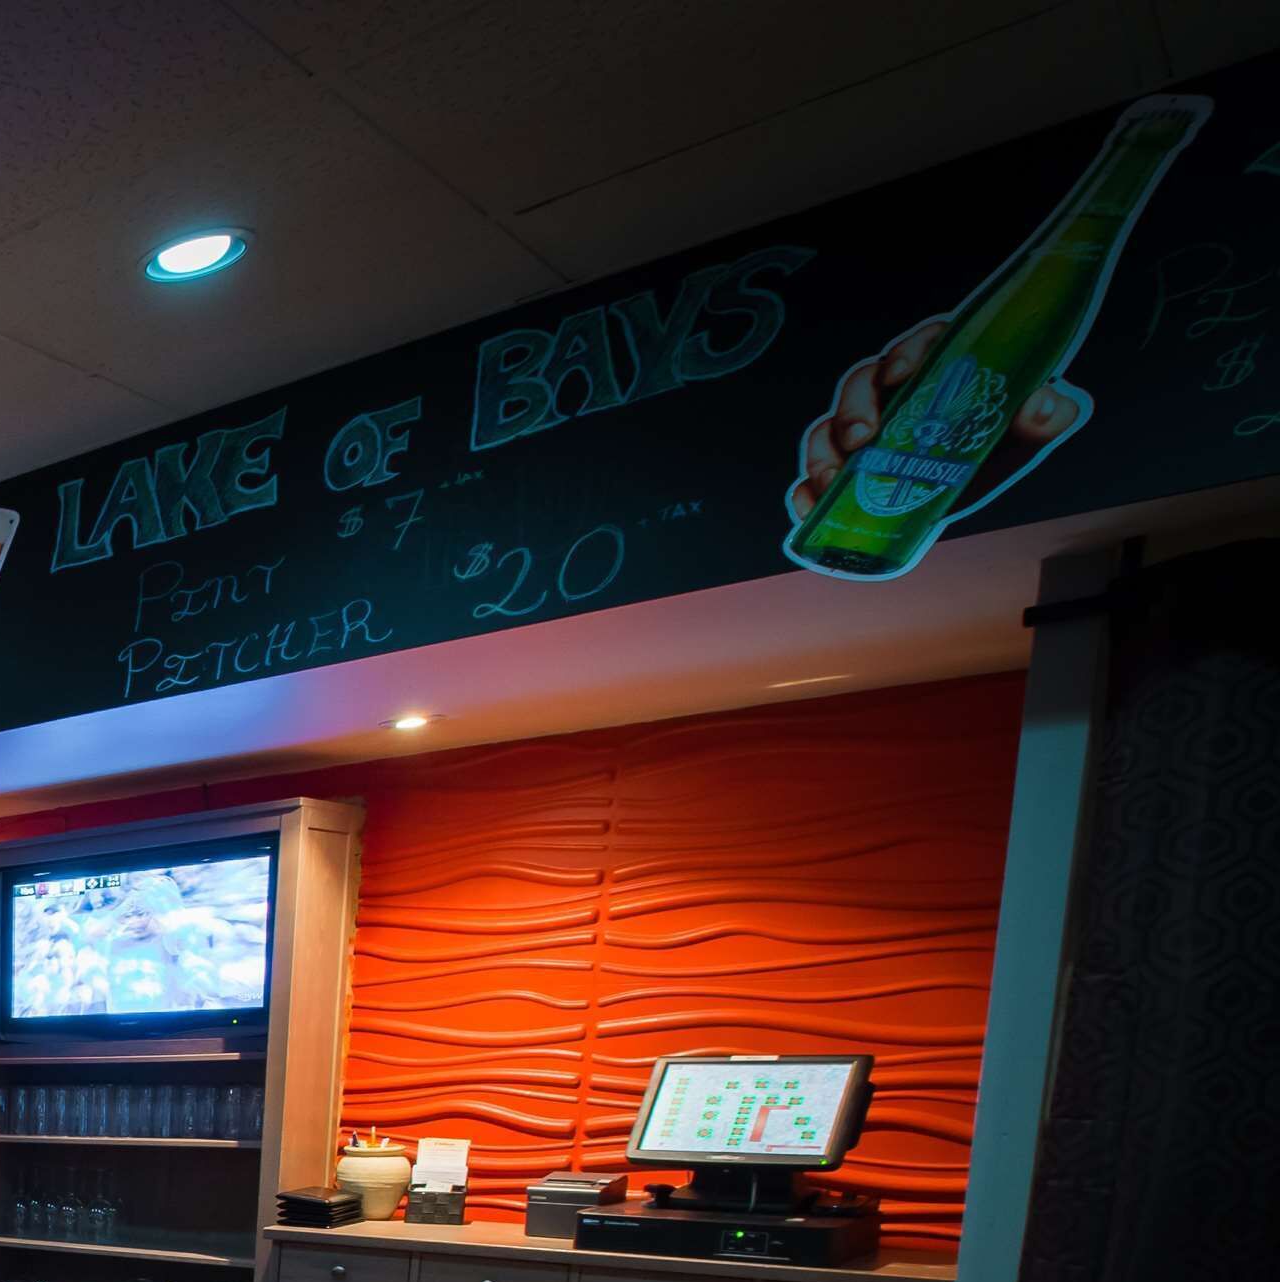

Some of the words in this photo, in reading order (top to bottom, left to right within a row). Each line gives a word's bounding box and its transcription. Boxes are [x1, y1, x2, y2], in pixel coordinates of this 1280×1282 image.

[48, 404, 288, 575] LAKE
[323, 395, 422, 492] OF
[469, 244, 818, 453] BAYS
[117, 599, 394, 698] PITCHER
